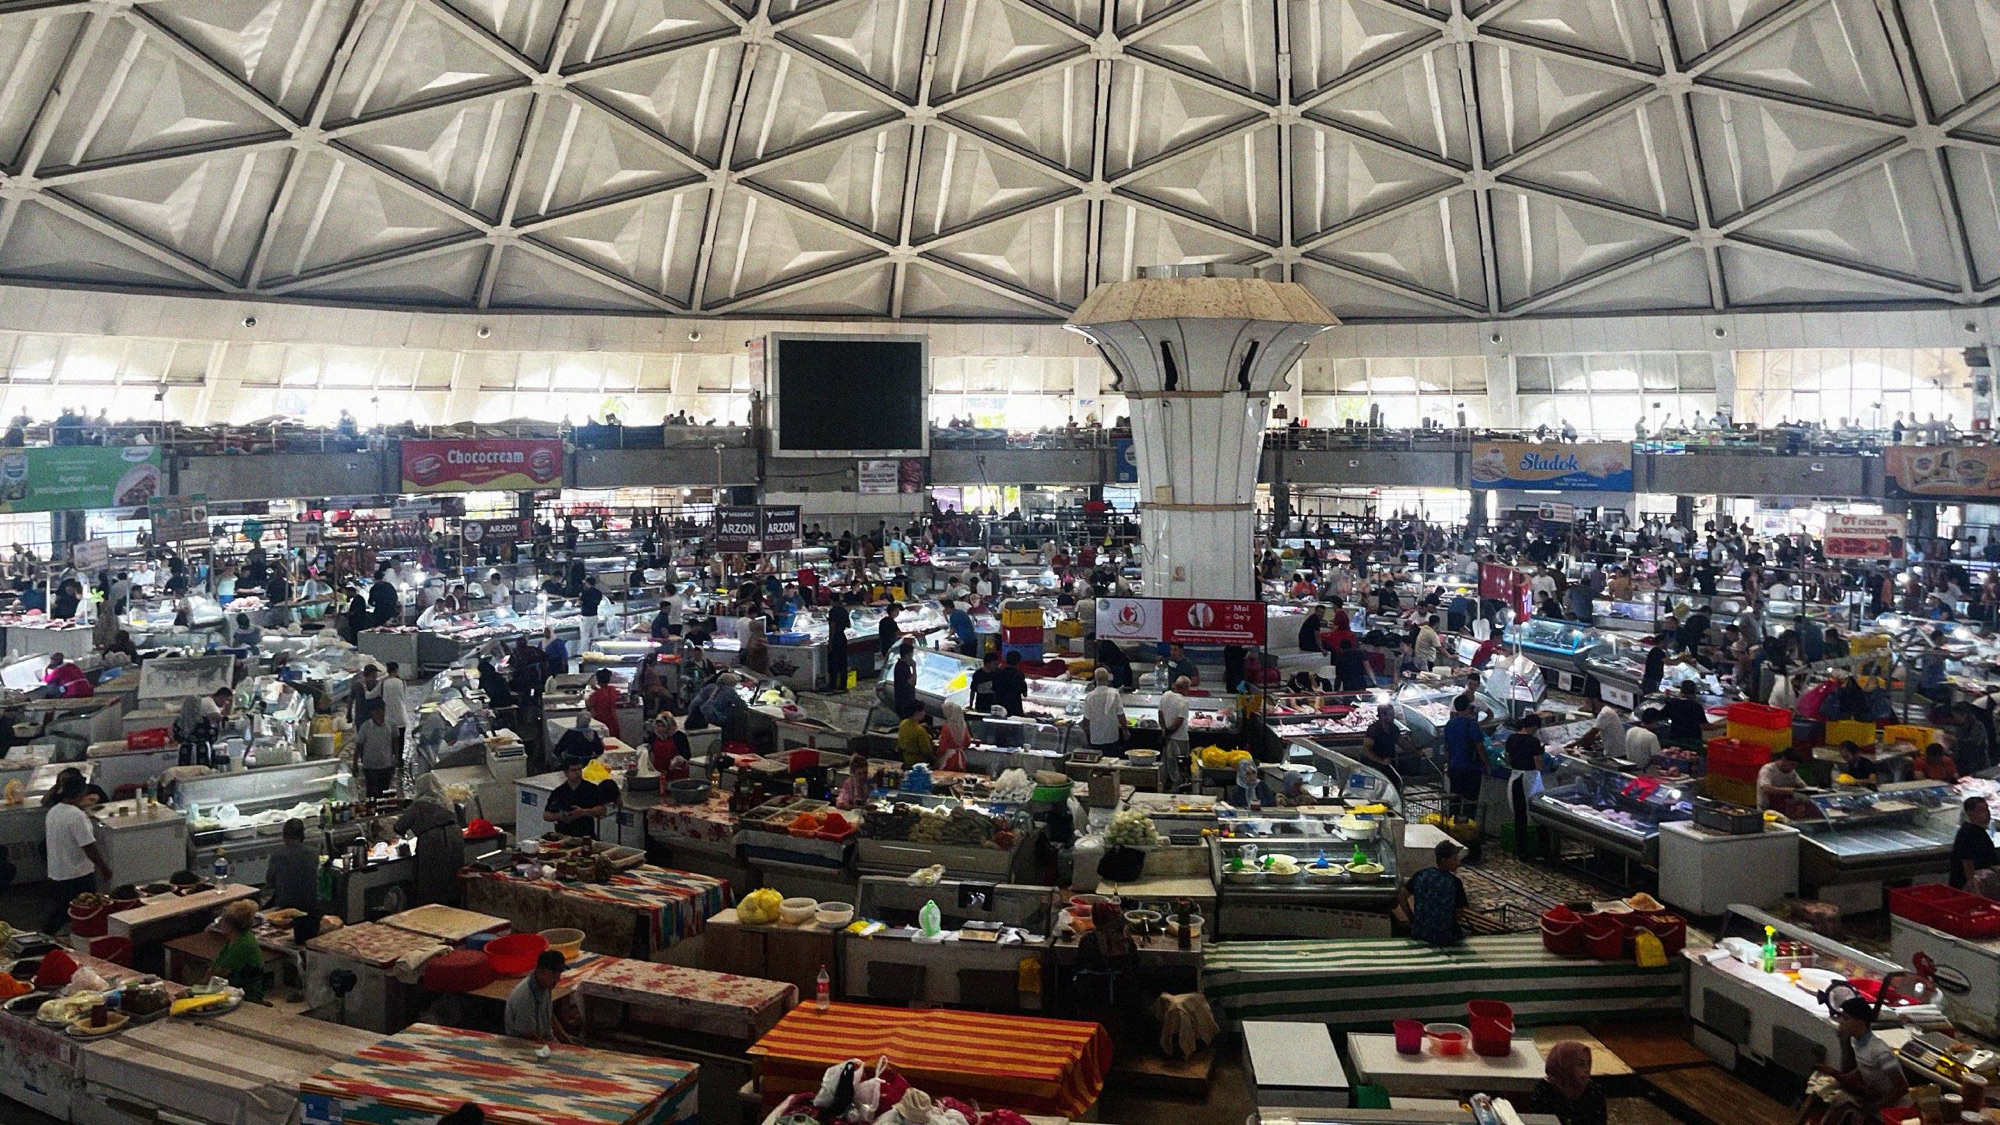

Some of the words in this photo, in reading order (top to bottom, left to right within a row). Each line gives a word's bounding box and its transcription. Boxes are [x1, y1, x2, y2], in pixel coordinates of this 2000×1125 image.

[447, 450, 524, 464] Chococream
[1519, 453, 1579, 471] Sladok
[721, 523, 756, 534] ARZON
[767, 522, 796, 533] ARZON
